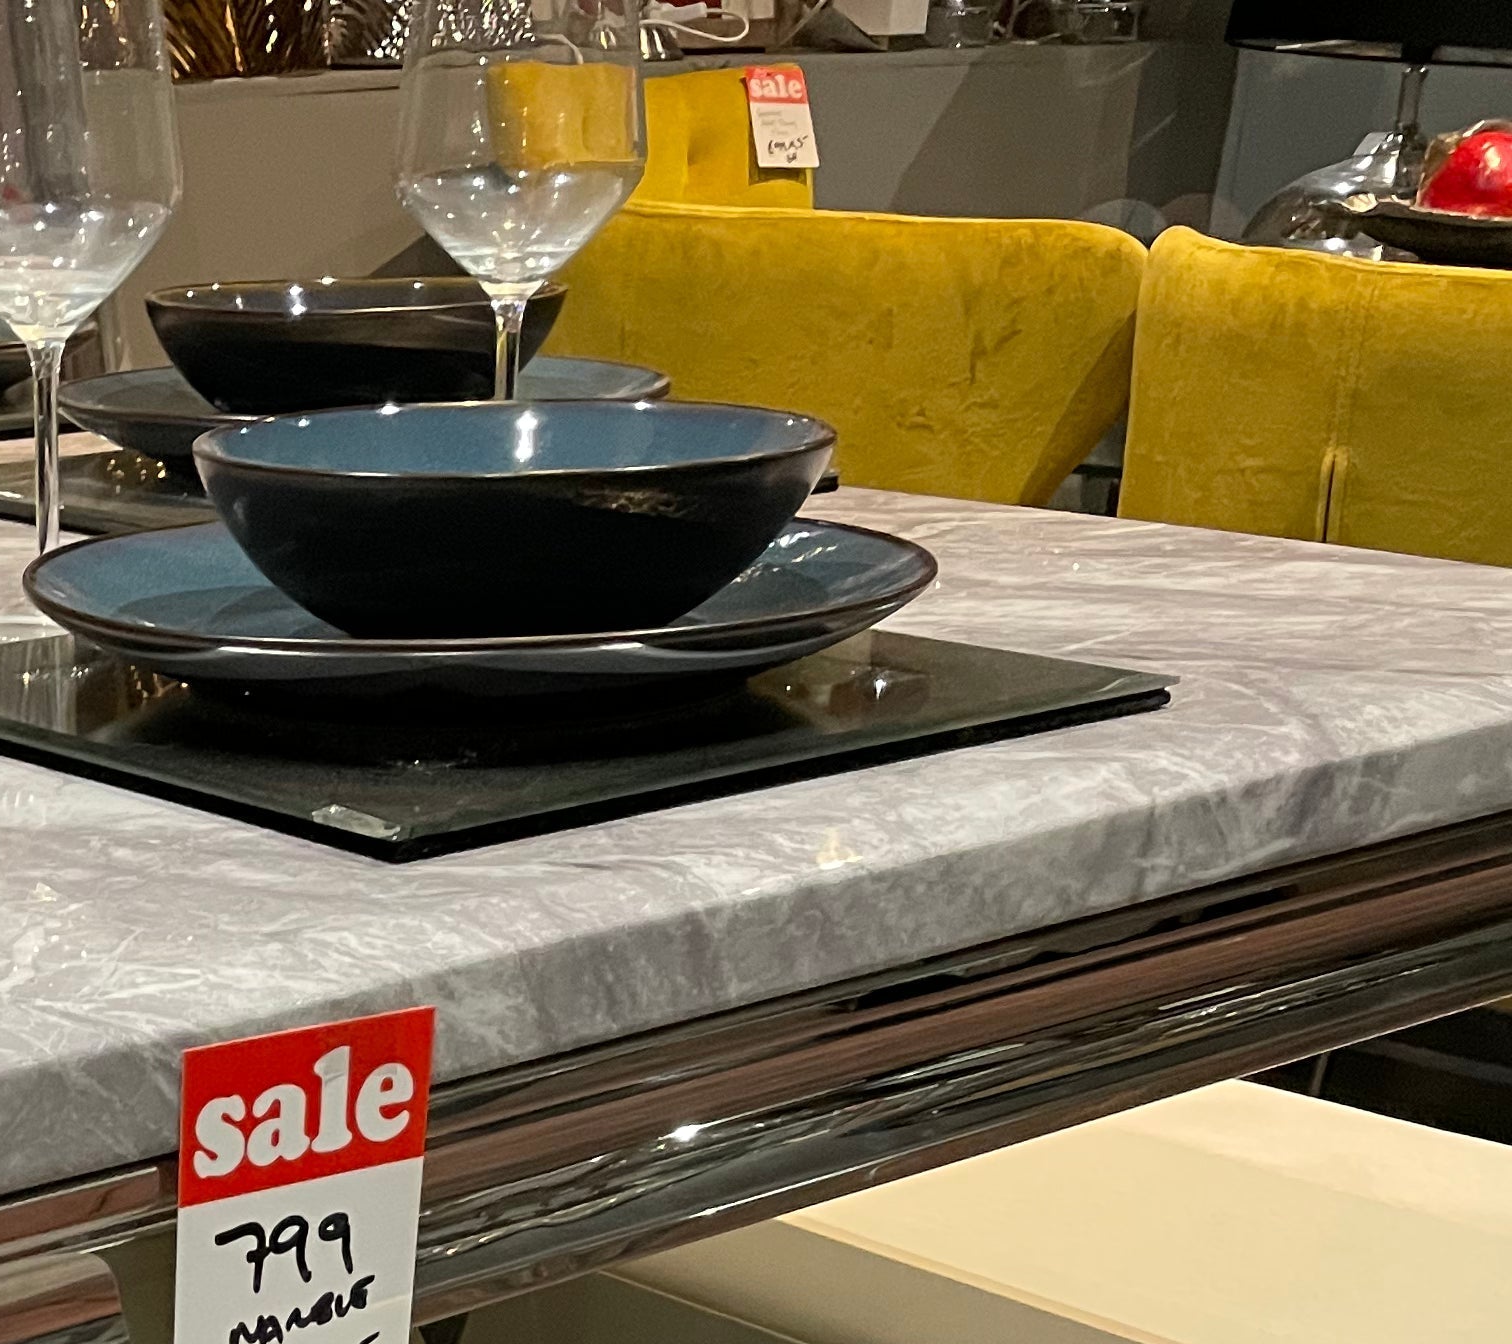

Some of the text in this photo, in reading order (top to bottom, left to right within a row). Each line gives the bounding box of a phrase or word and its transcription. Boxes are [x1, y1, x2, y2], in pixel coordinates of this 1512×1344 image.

[749, 74, 803, 99] sale
[193, 1045, 415, 1179] sale
[215, 1212, 353, 1293] 799
